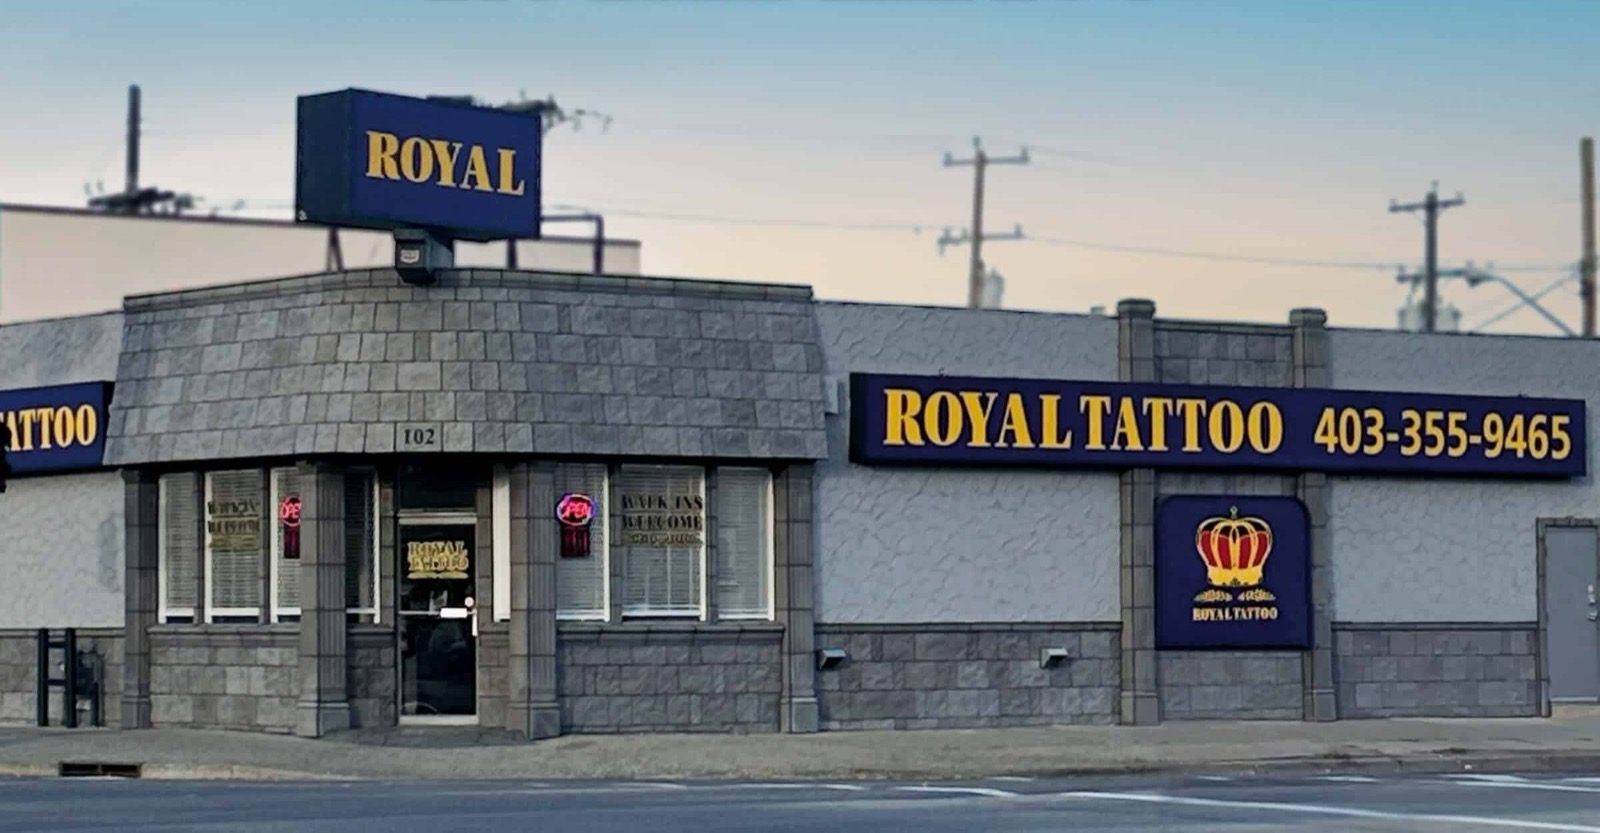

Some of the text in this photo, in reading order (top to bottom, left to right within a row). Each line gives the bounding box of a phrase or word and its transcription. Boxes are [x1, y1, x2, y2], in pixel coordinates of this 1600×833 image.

[365, 130, 526, 197] ROYAL
[0, 403, 97, 452] ATTOO
[882, 388, 1572, 460] ROYAL TATTOO 403-355-9465
[404, 428, 436, 445] 102
[560, 500, 592, 519] OPEN
[407, 540, 467, 557] ROYAL
[1192, 606, 1278, 621] ROYAL TATTOO
